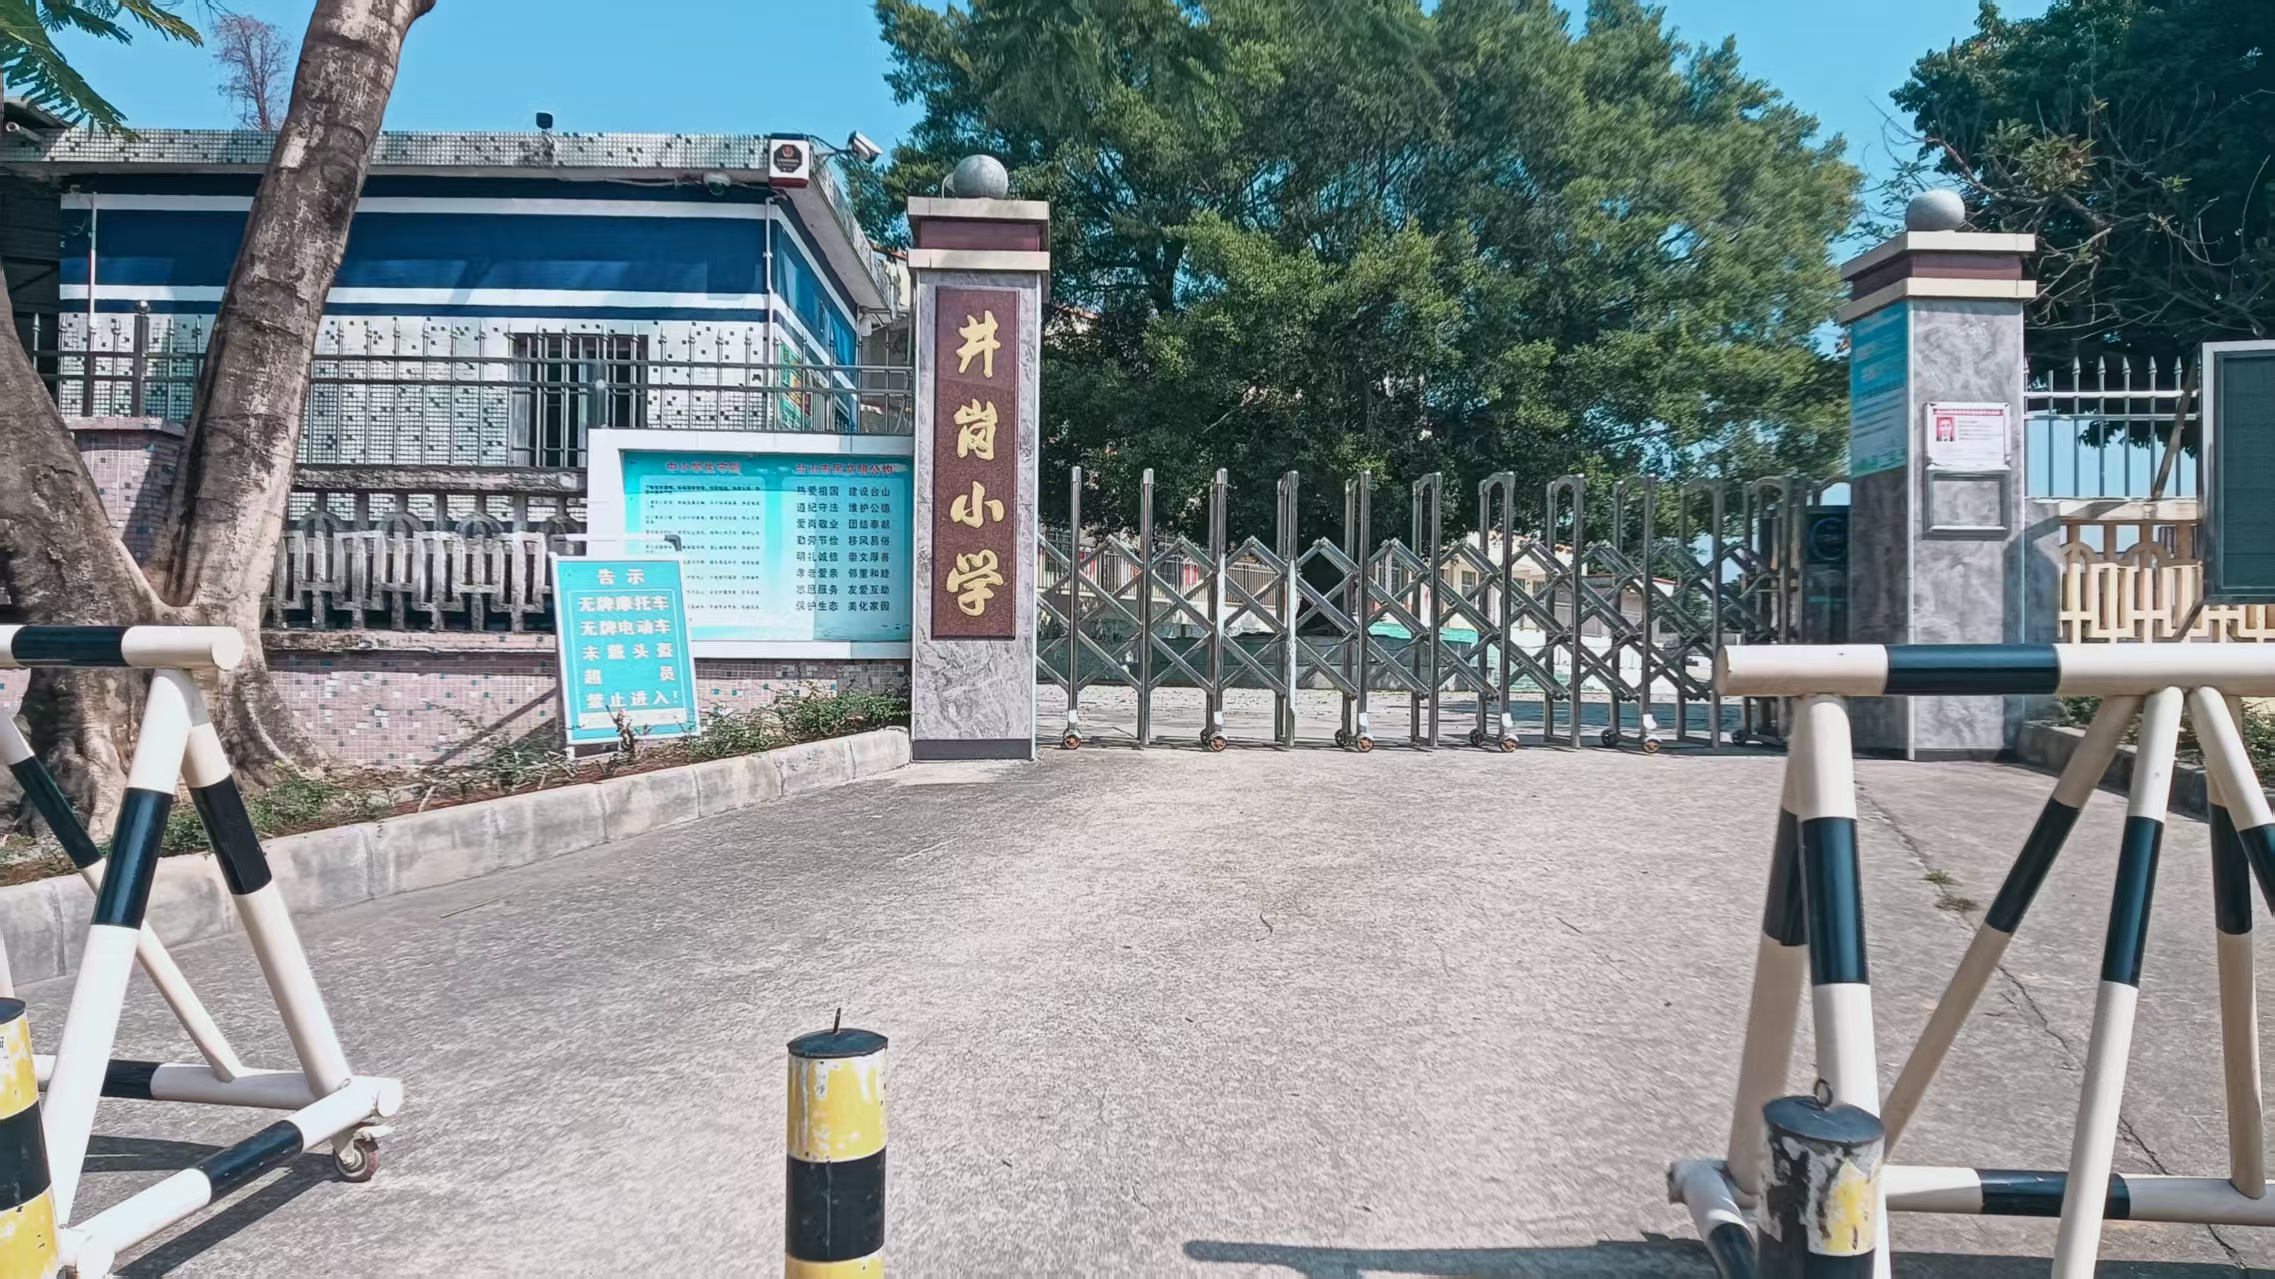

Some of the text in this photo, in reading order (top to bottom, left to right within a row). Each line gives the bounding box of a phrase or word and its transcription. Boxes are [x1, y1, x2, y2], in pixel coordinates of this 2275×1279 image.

[946, 309, 1004, 617] 井岗小学
[796, 463, 894, 475] 台山市民文明公约
[797, 486, 890, 497] 热爱祖国 建设台山
[849, 503, 890, 513] 维护公德
[797, 519, 890, 529] 爱岗敬业 团结奉献
[797, 536, 890, 546] 勤劳节俭 移风易俗
[796, 552, 889, 562] 明礼诚信 崇文厚善
[597, 568, 645, 586] 告示
[848, 568, 889, 578] 邻里和睦
[796, 585, 889, 595] 志愿服务 友爱互助
[577, 596, 669, 612] 无牌摩托车
[796, 601, 890, 611] 保护生态 美化家园
[580, 619, 671, 636] 无牌电动车
[582, 642, 674, 660] 未戴头盔
